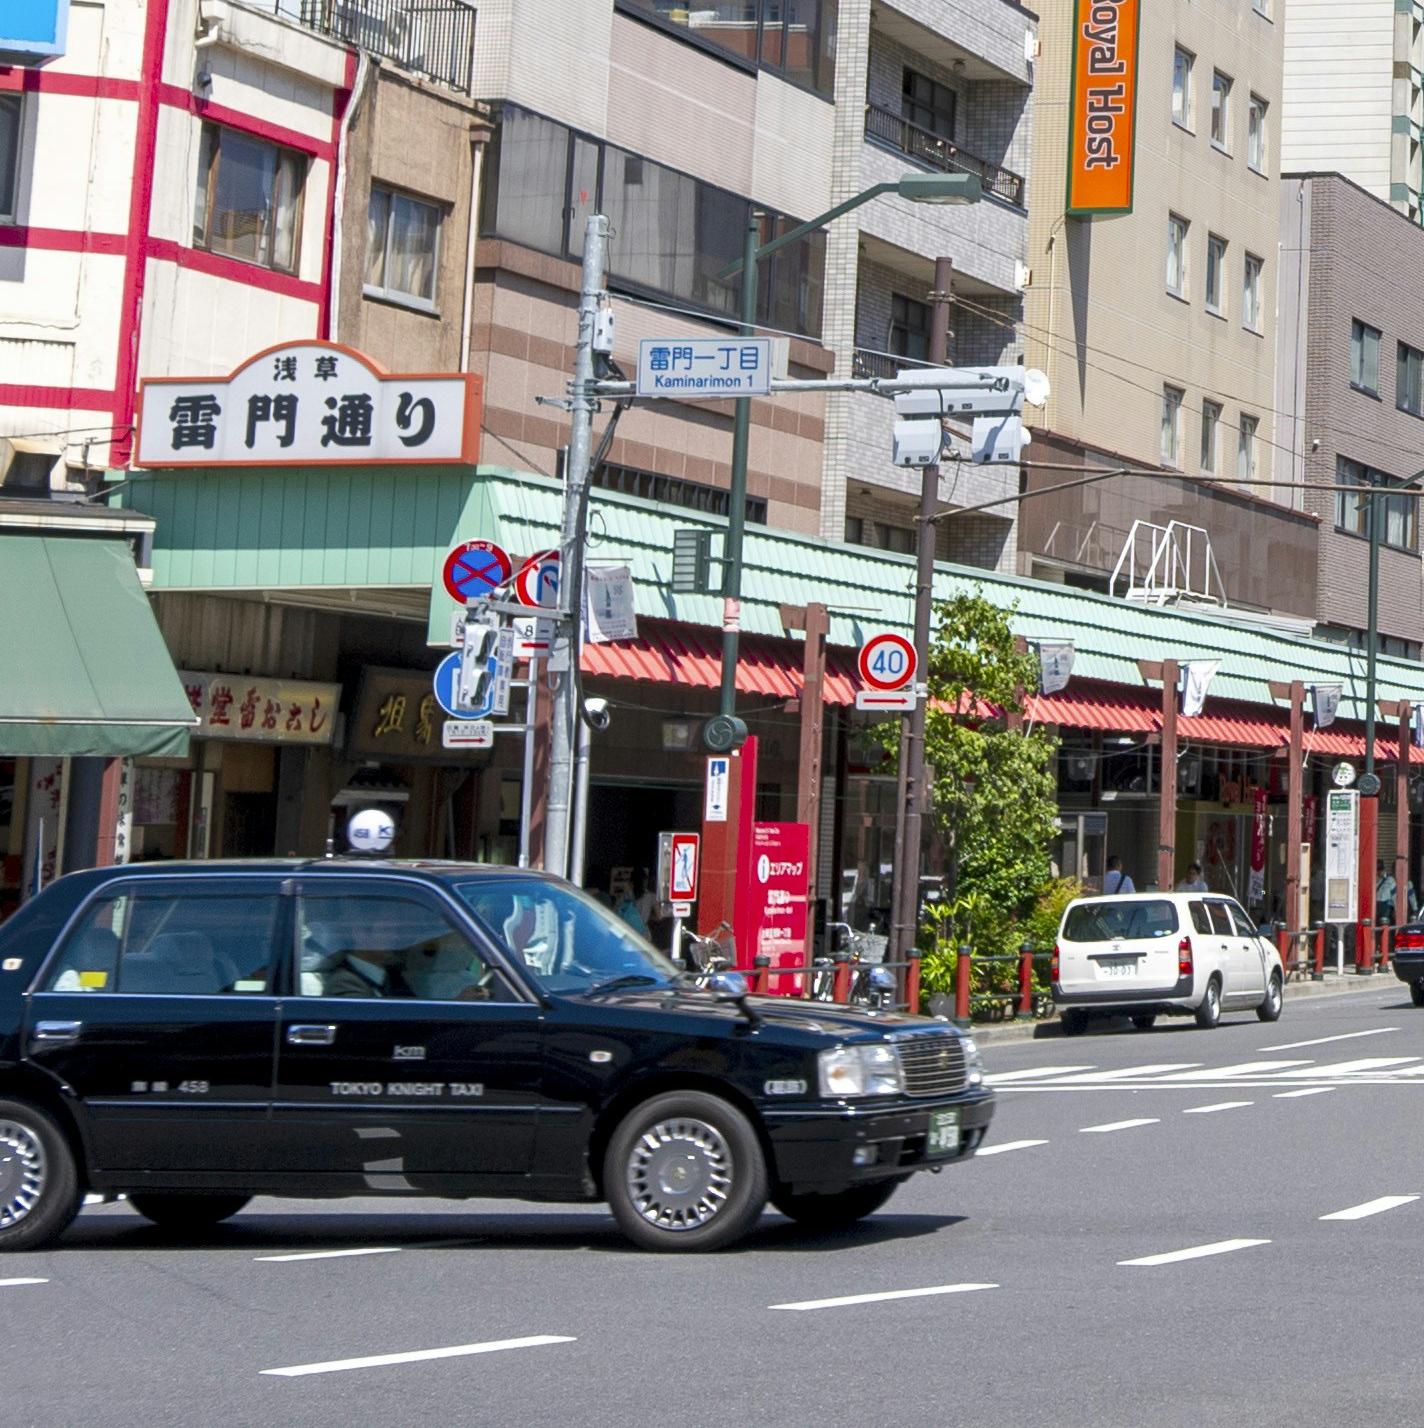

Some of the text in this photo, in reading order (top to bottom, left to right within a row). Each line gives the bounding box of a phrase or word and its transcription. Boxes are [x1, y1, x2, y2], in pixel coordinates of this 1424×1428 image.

[1084, 83, 1127, 170] Host
[273, 355, 339, 383] 浅草
[649, 346, 759, 371] 雷門一丁目
[655, 375, 753, 388] Kaminarimon 1
[169, 391, 437, 451] 雷門通り
[872, 649, 903, 674] 40
[769, 862, 803, 876] エリアマップ
[330, 1082, 484, 1097] TOKYO KNIGHT TAXI
